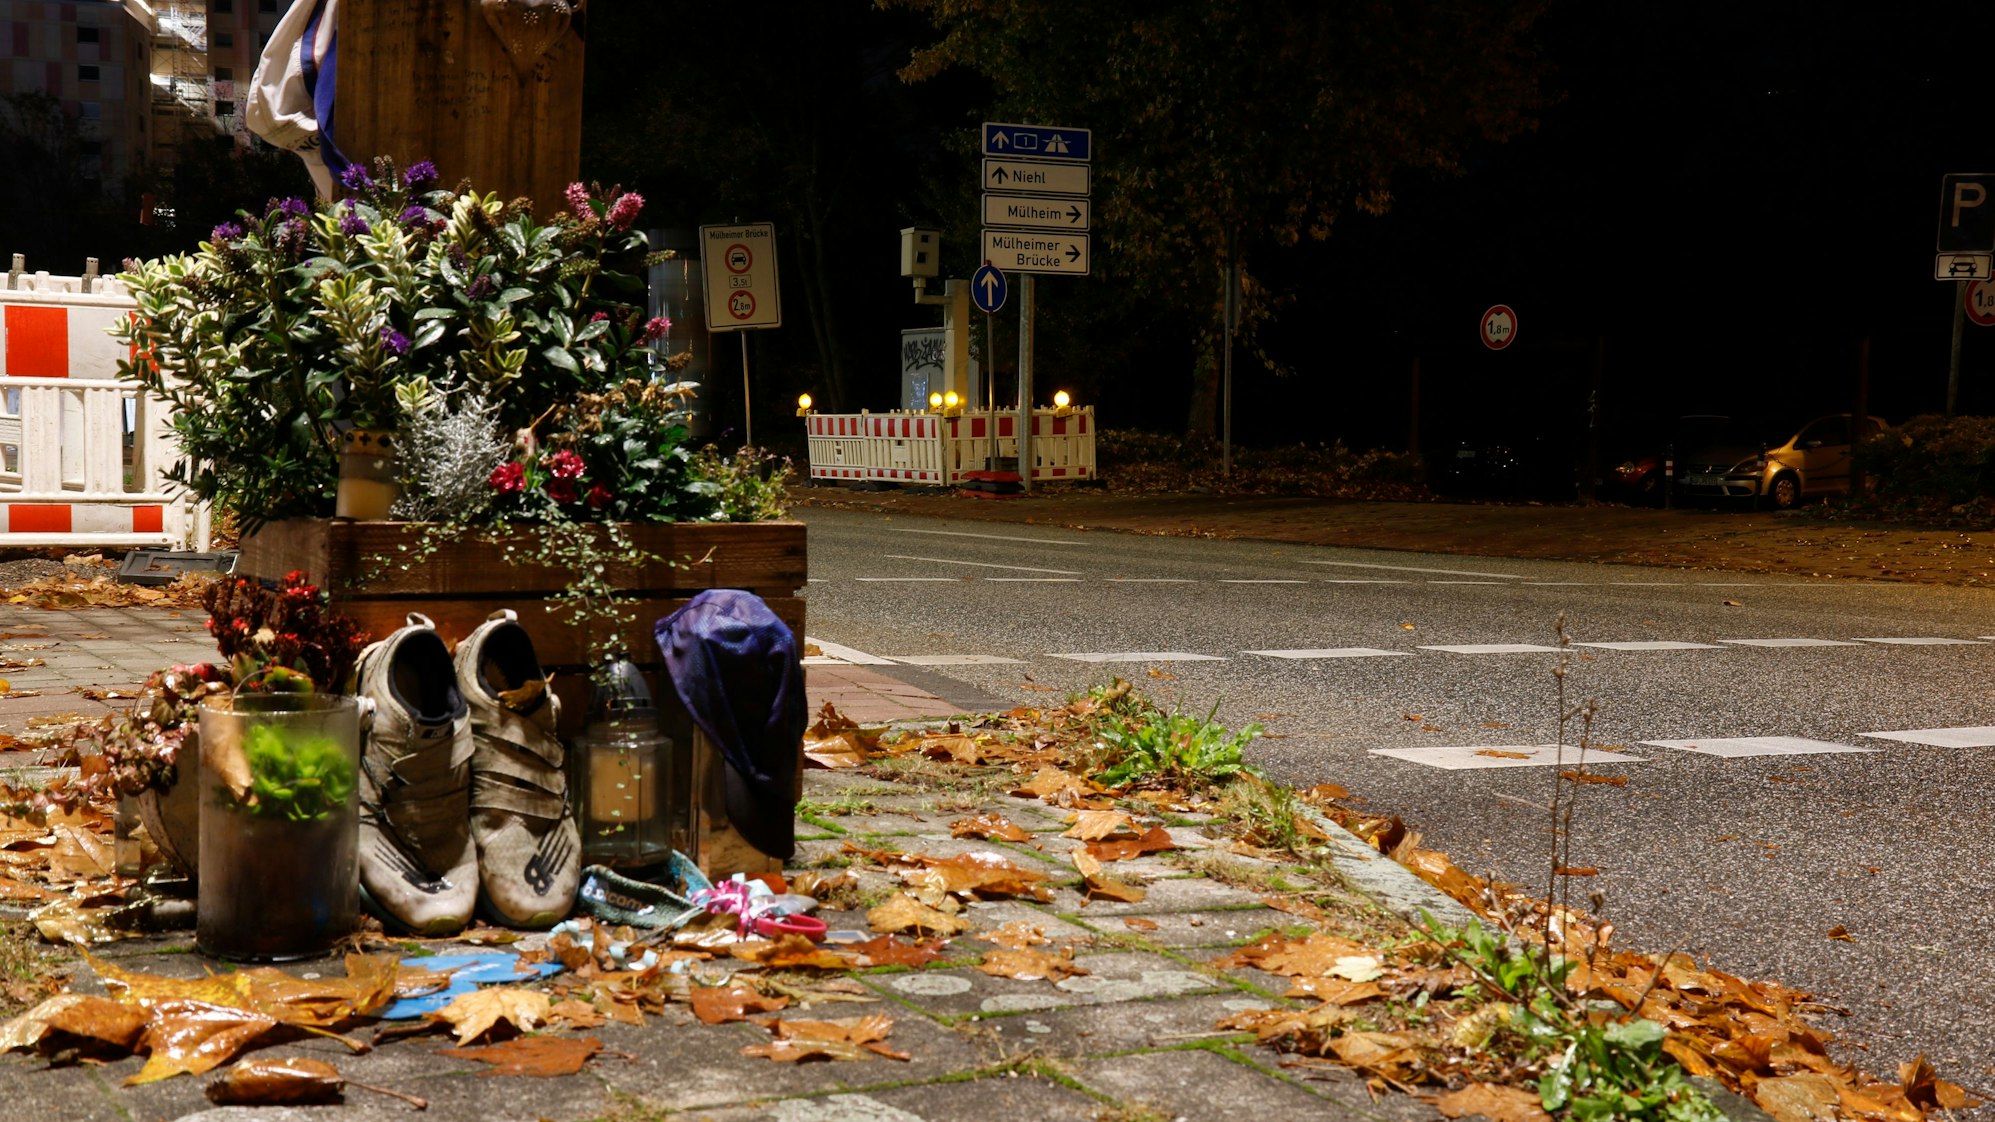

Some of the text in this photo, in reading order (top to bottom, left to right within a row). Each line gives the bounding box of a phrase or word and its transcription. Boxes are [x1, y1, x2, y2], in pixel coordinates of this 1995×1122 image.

[1023, 136, 1028, 147] 1
[1013, 170, 1046, 184] Niehl
[1952, 182, 1987, 228] P
[1008, 205, 1061, 220] Mülheim
[709, 229, 769, 240] Mülheimer Brücke
[992, 236, 1060, 251] Mülheimer
[1017, 253, 1061, 267] Brücke
